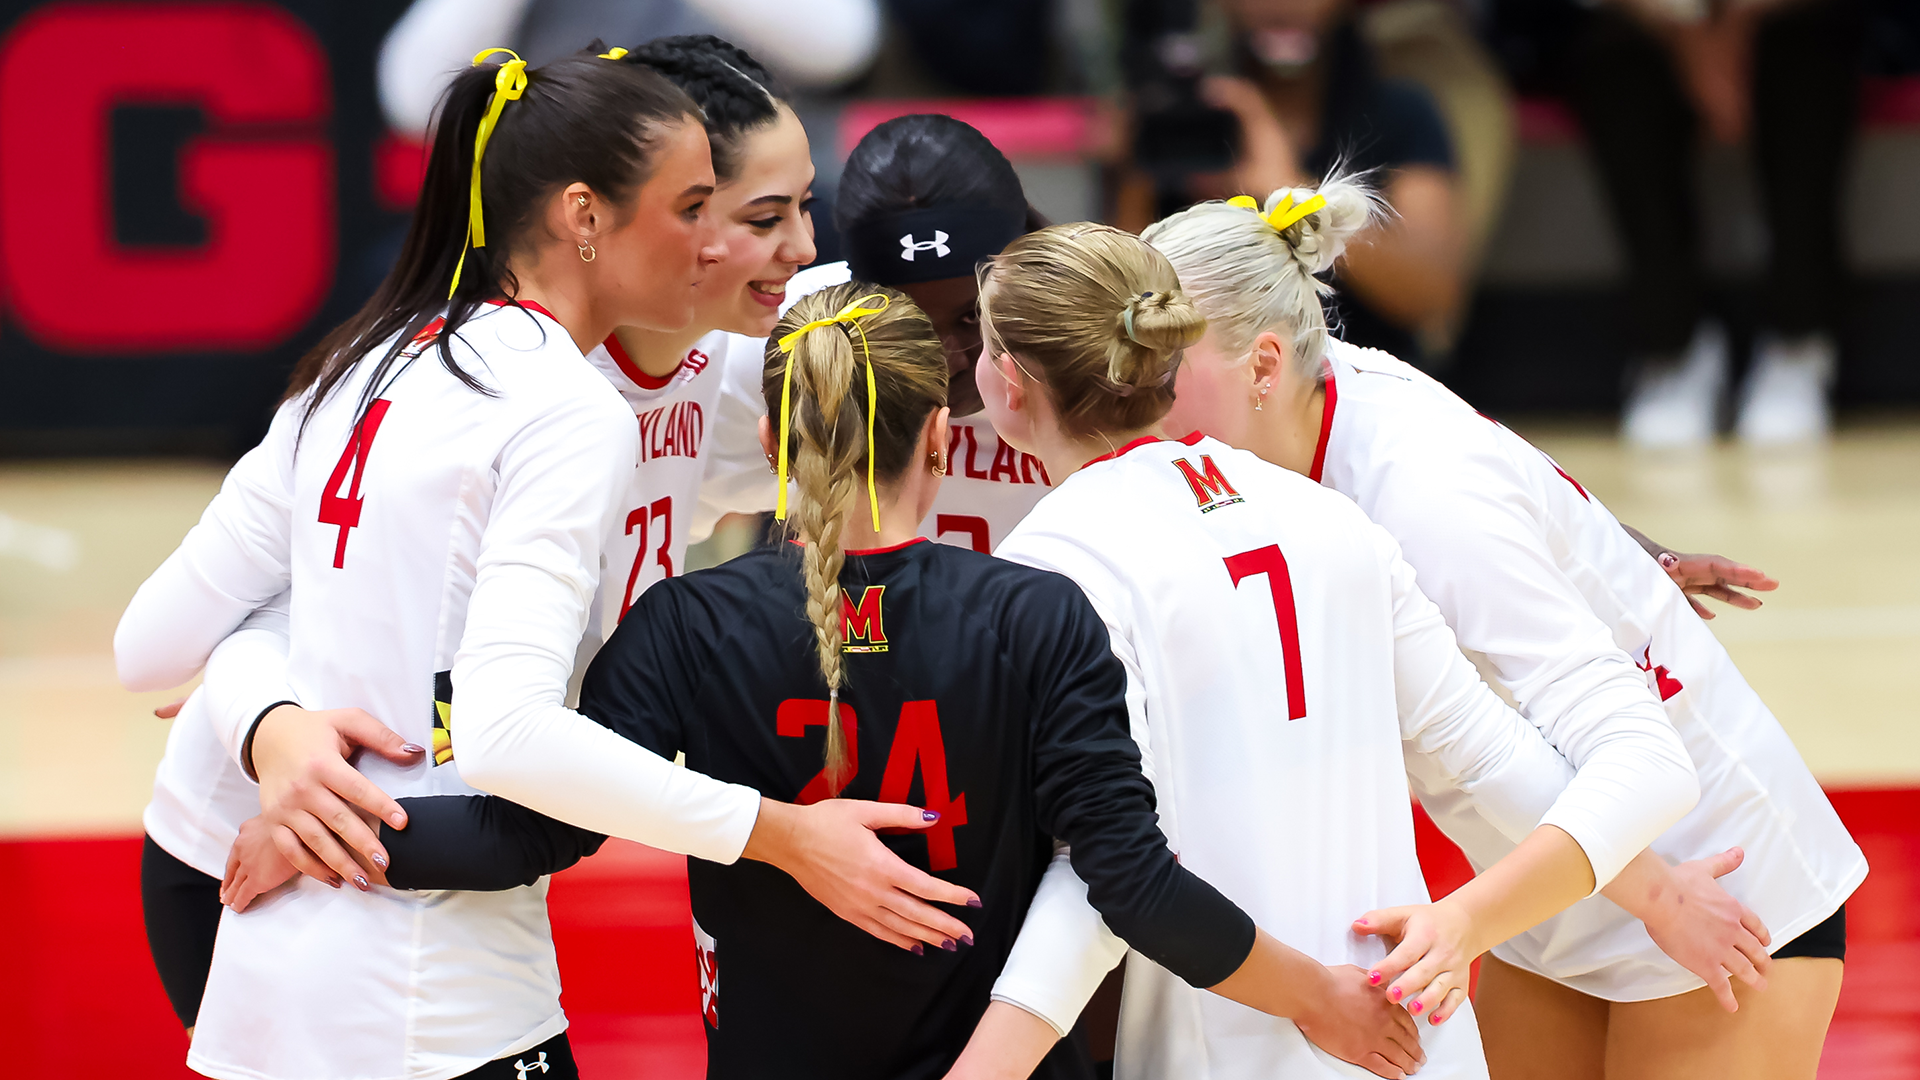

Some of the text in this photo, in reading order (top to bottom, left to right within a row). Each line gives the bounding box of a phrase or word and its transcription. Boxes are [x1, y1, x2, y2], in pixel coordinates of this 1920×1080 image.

[318, 398, 392, 569] 4
[1171, 454, 1240, 507] M
[1222, 543, 1307, 721] 7
[776, 698, 968, 872] 24
